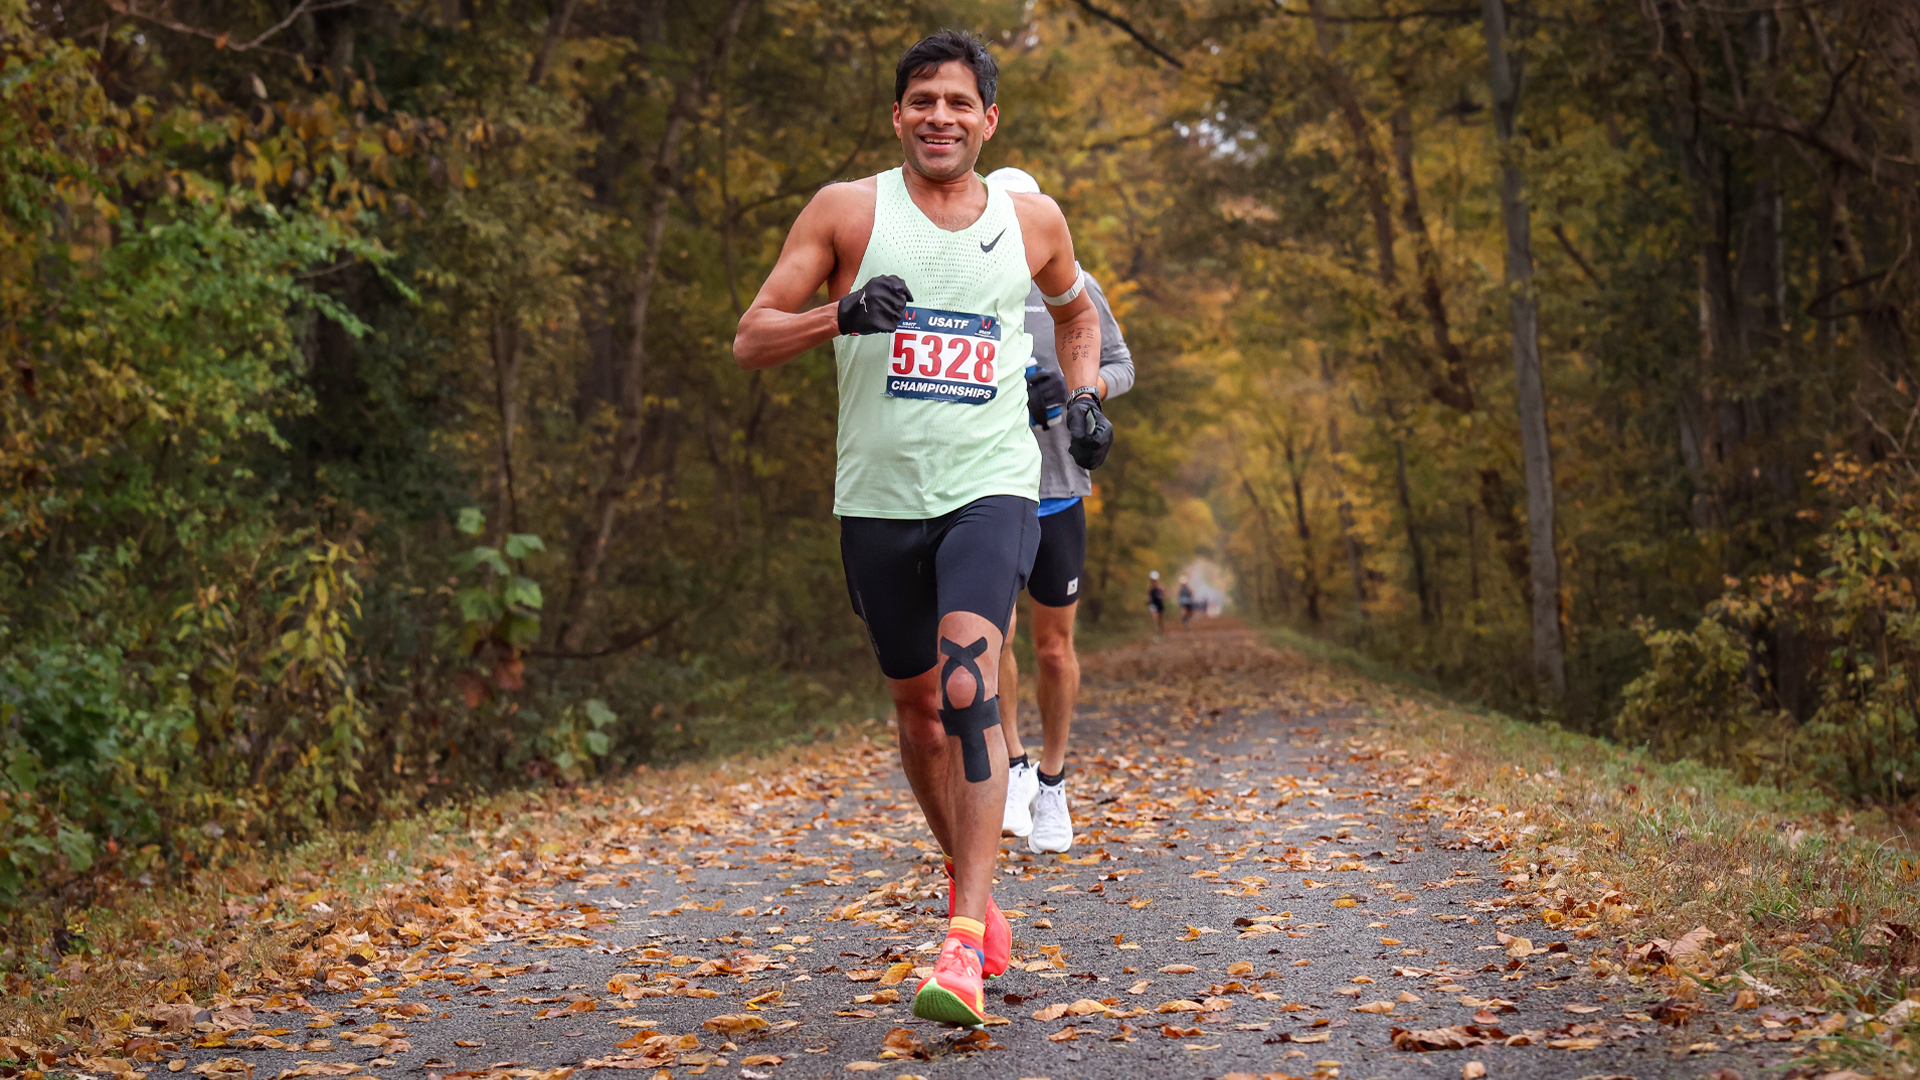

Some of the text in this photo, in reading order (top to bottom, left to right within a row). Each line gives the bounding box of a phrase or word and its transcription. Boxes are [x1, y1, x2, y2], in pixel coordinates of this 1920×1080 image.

[928, 316, 969, 329] USATF
[892, 332, 995, 383] 5328
[891, 380, 992, 399] CHAMPIONSHIPS
